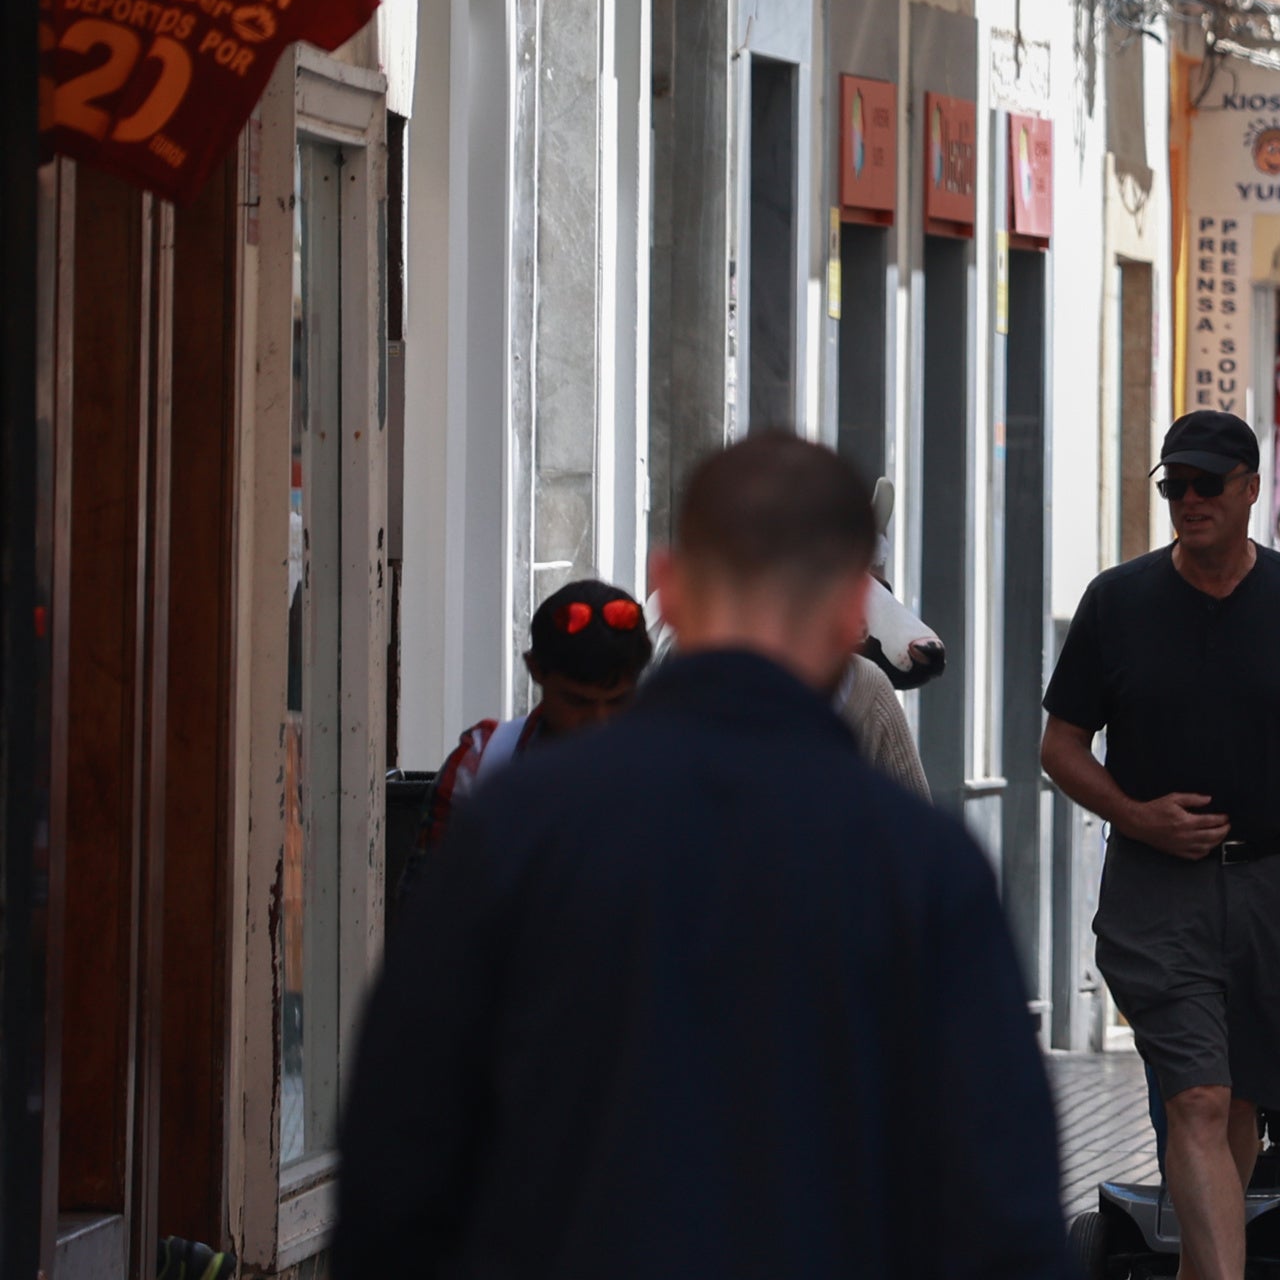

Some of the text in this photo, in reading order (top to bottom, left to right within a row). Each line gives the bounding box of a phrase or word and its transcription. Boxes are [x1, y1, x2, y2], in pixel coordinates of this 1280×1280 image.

[199, 28, 257, 76] POR
[1196, 217, 1215, 332] PRENSA
[1221, 219, 1238, 314] PRESS
